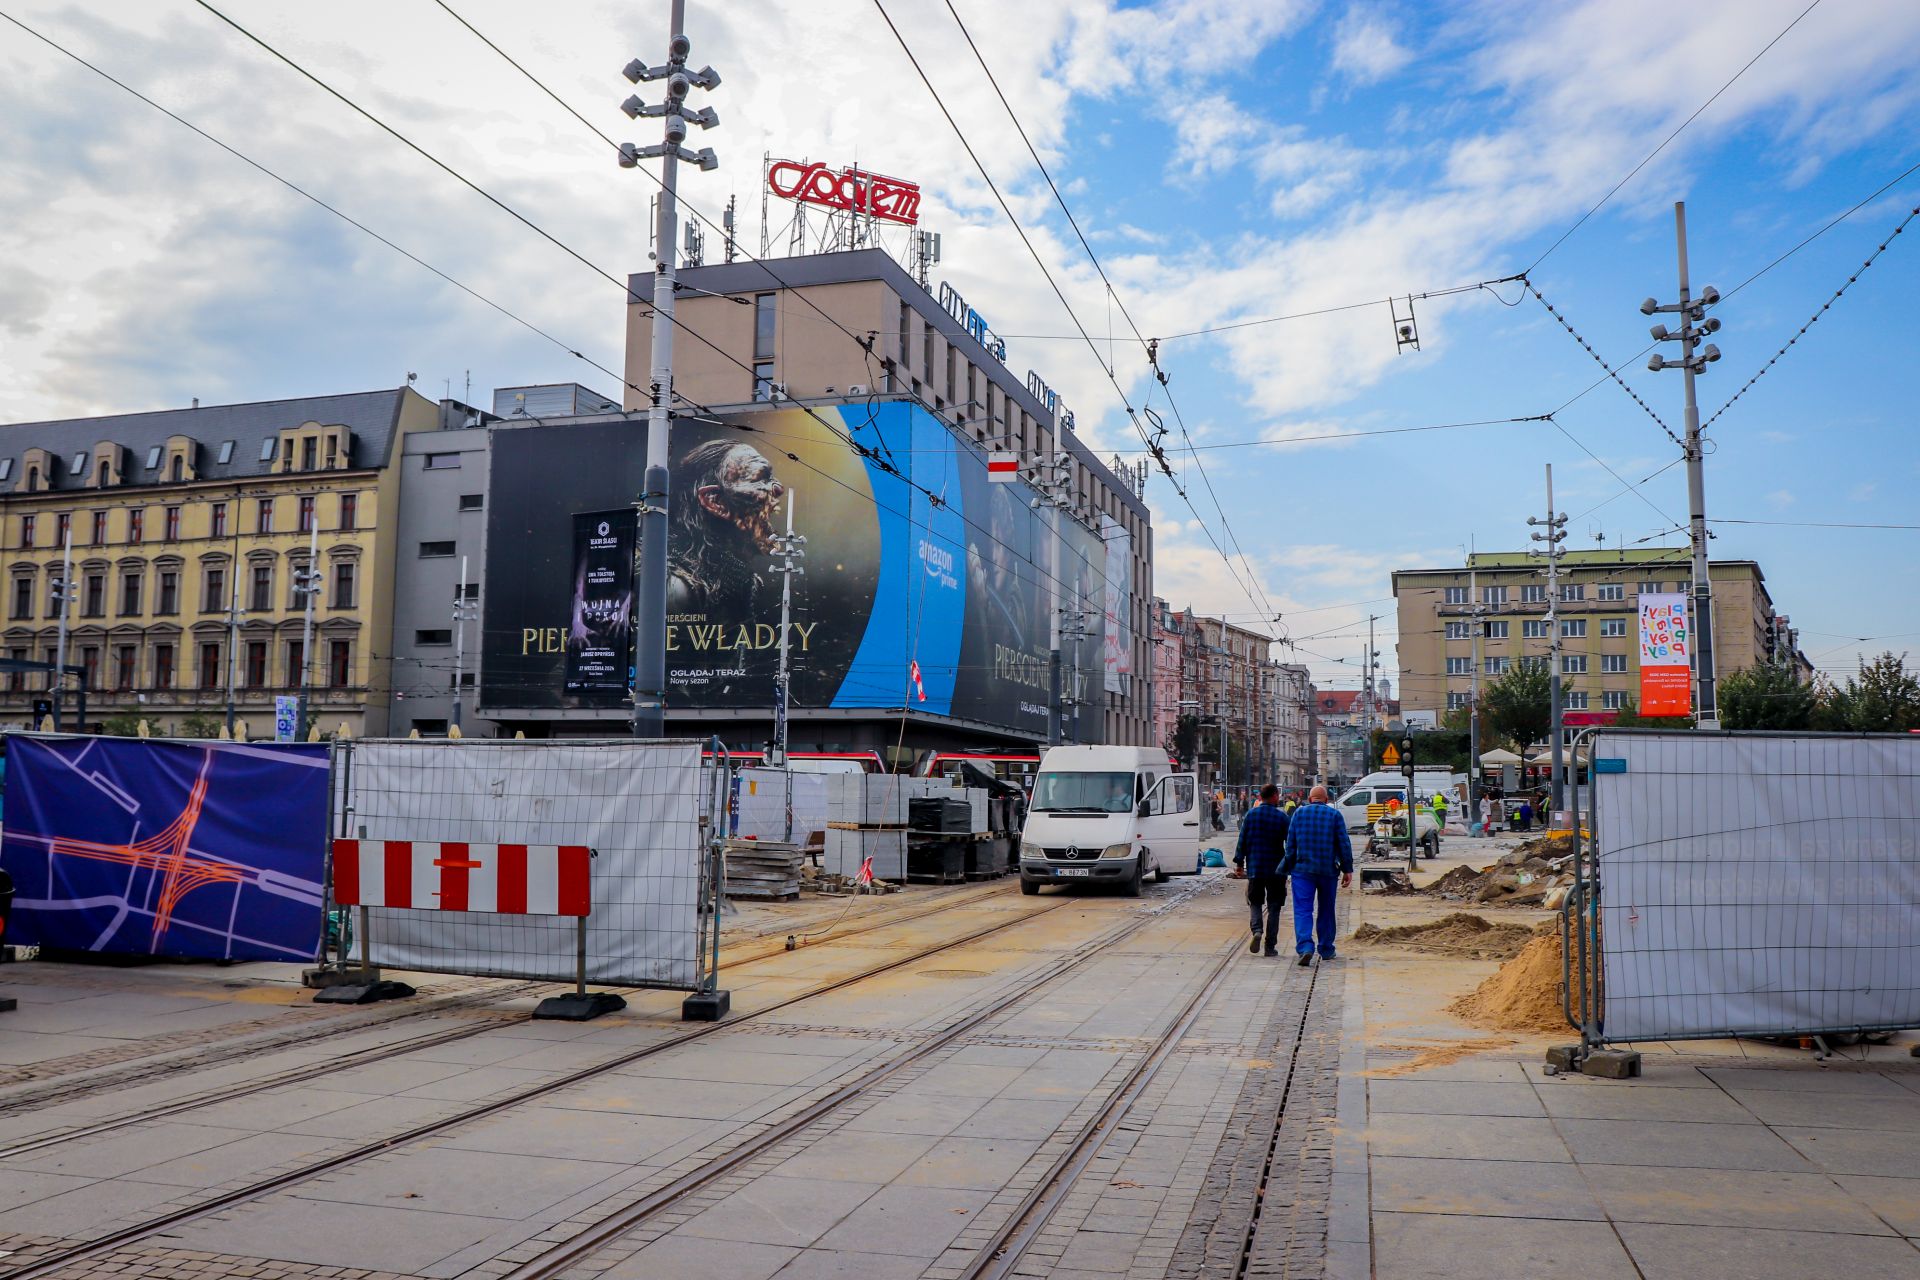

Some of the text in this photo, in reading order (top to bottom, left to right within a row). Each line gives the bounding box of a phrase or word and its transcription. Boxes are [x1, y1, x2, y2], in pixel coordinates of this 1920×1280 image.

[919, 539, 952, 573] amazon
[941, 572, 957, 590] prime
[581, 599, 620, 611] WOJNA
[665, 613, 707, 623] IERŚCIENI
[670, 669, 714, 678] OGLĄDAJ
[670, 677, 689, 686] Nowy
